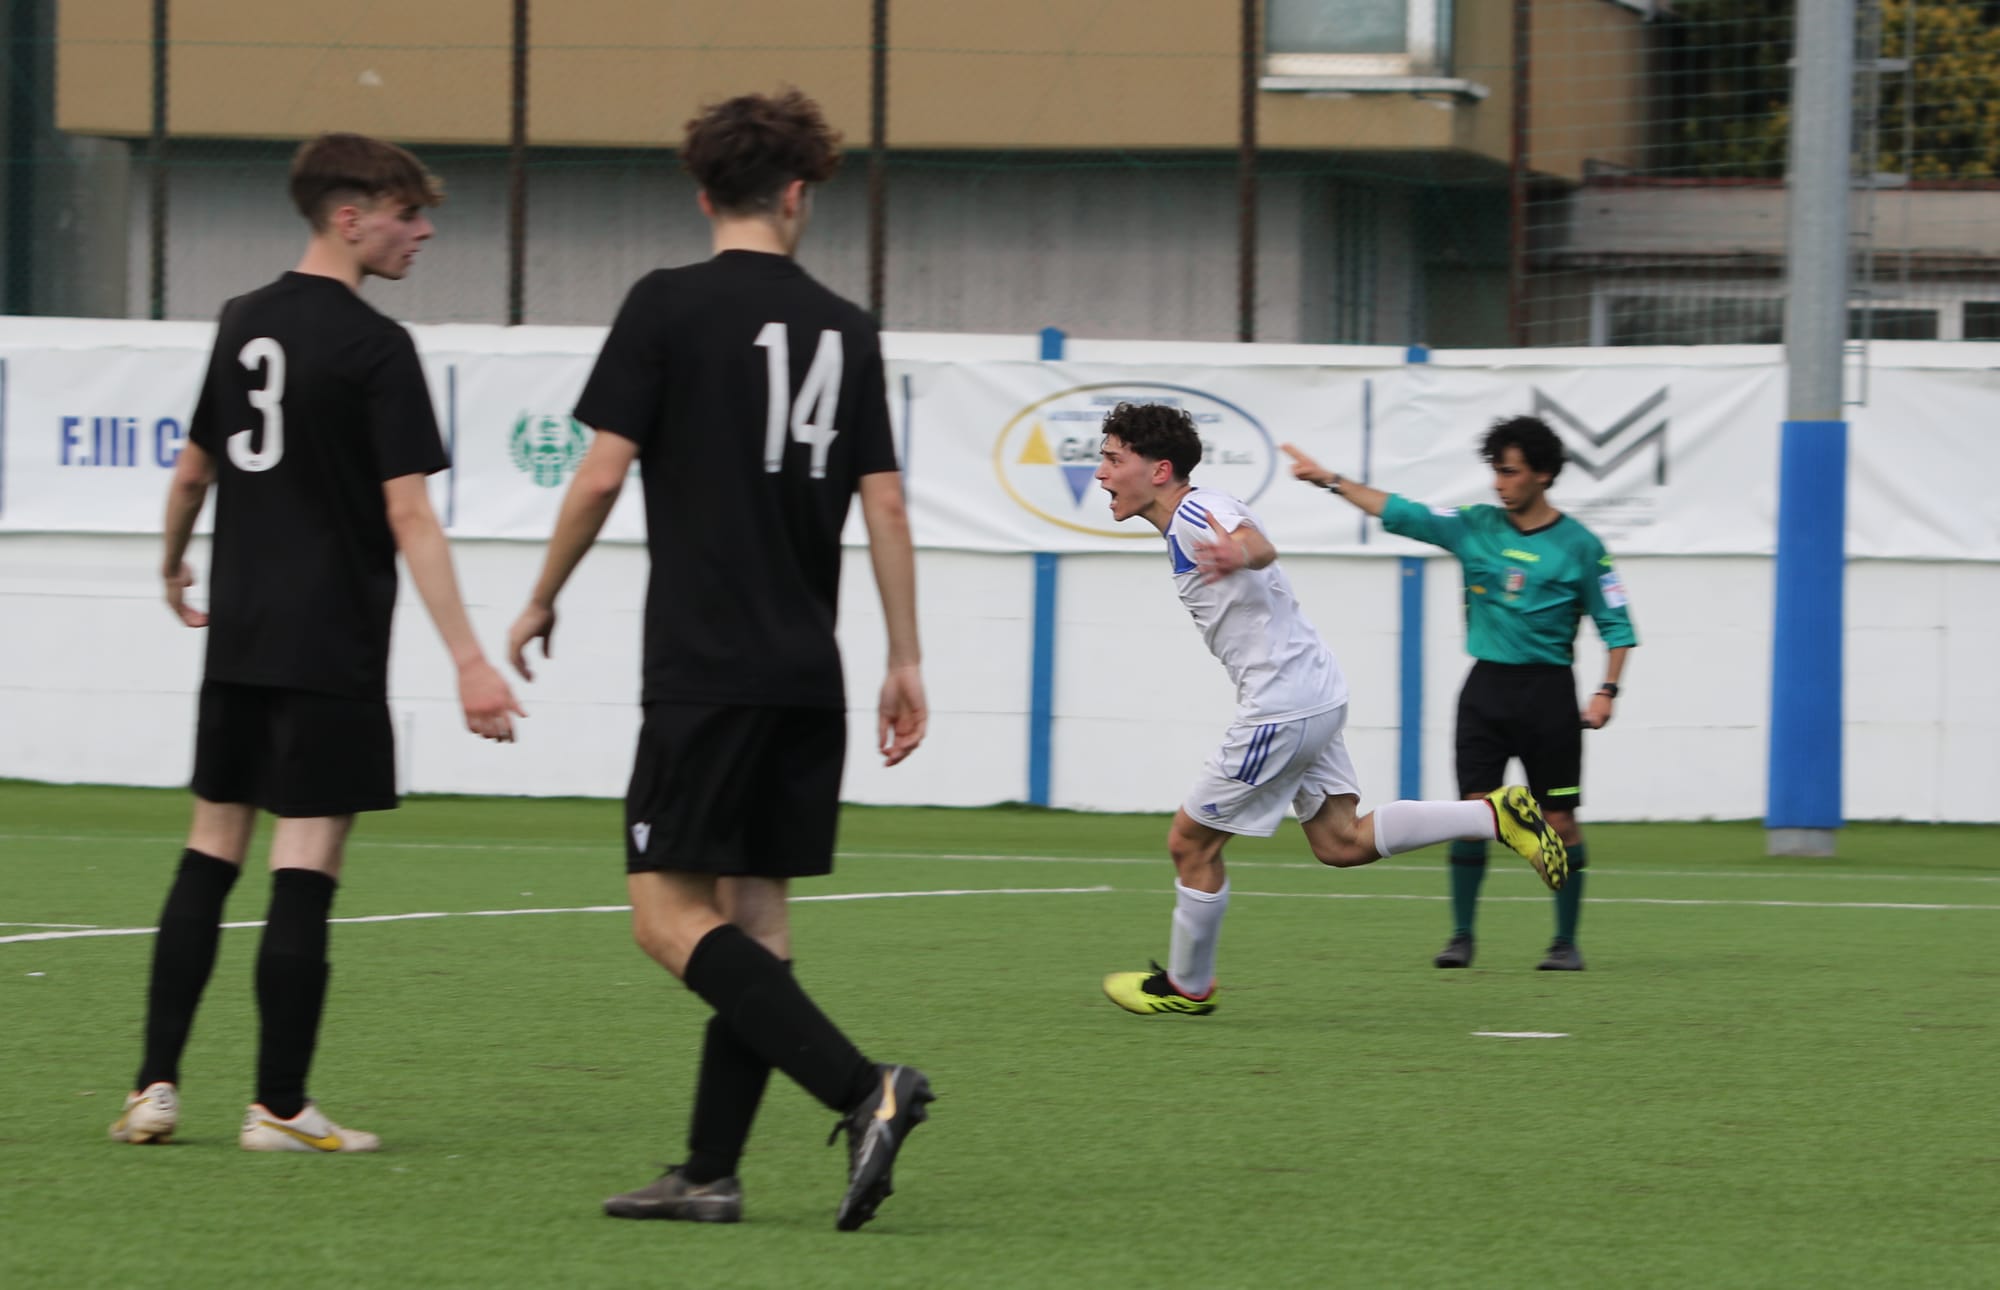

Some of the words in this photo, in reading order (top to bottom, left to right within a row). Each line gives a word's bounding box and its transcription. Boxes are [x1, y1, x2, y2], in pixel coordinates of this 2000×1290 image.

[155, 417, 186, 468] C
[227, 337, 286, 472] 3
[753, 322, 844, 479] 14
